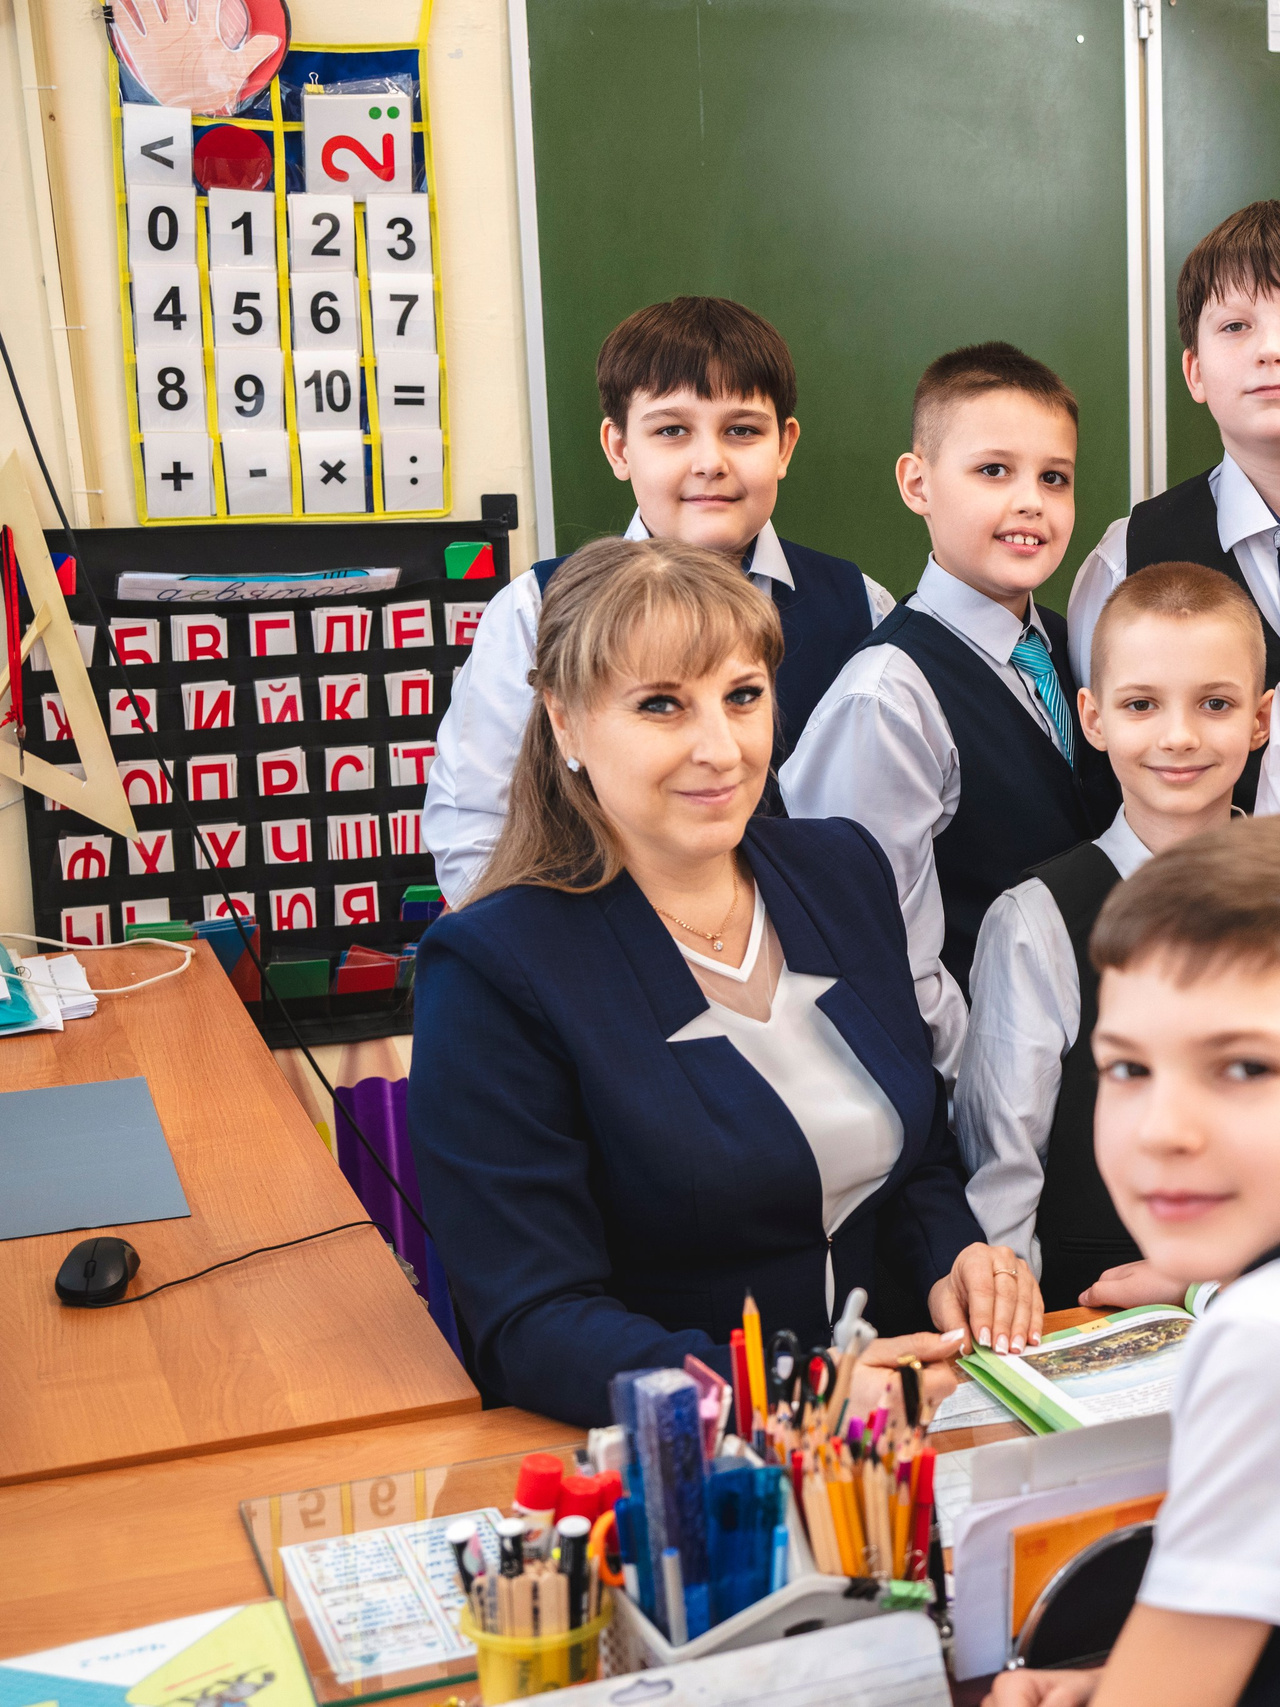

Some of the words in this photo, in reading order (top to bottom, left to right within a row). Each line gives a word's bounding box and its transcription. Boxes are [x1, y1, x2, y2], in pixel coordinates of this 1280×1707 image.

[148, 206, 178, 251] 0
[231, 212, 252, 255] 1
[311, 213, 340, 256] 2
[387, 218, 416, 260] 3
[154, 287, 187, 330] 4
[232, 292, 263, 335] 5
[311, 291, 341, 334] 6
[390, 294, 418, 336] 7
[157, 367, 188, 411] 8
[234, 374, 265, 417] 9
[304, 370, 352, 412] 10
